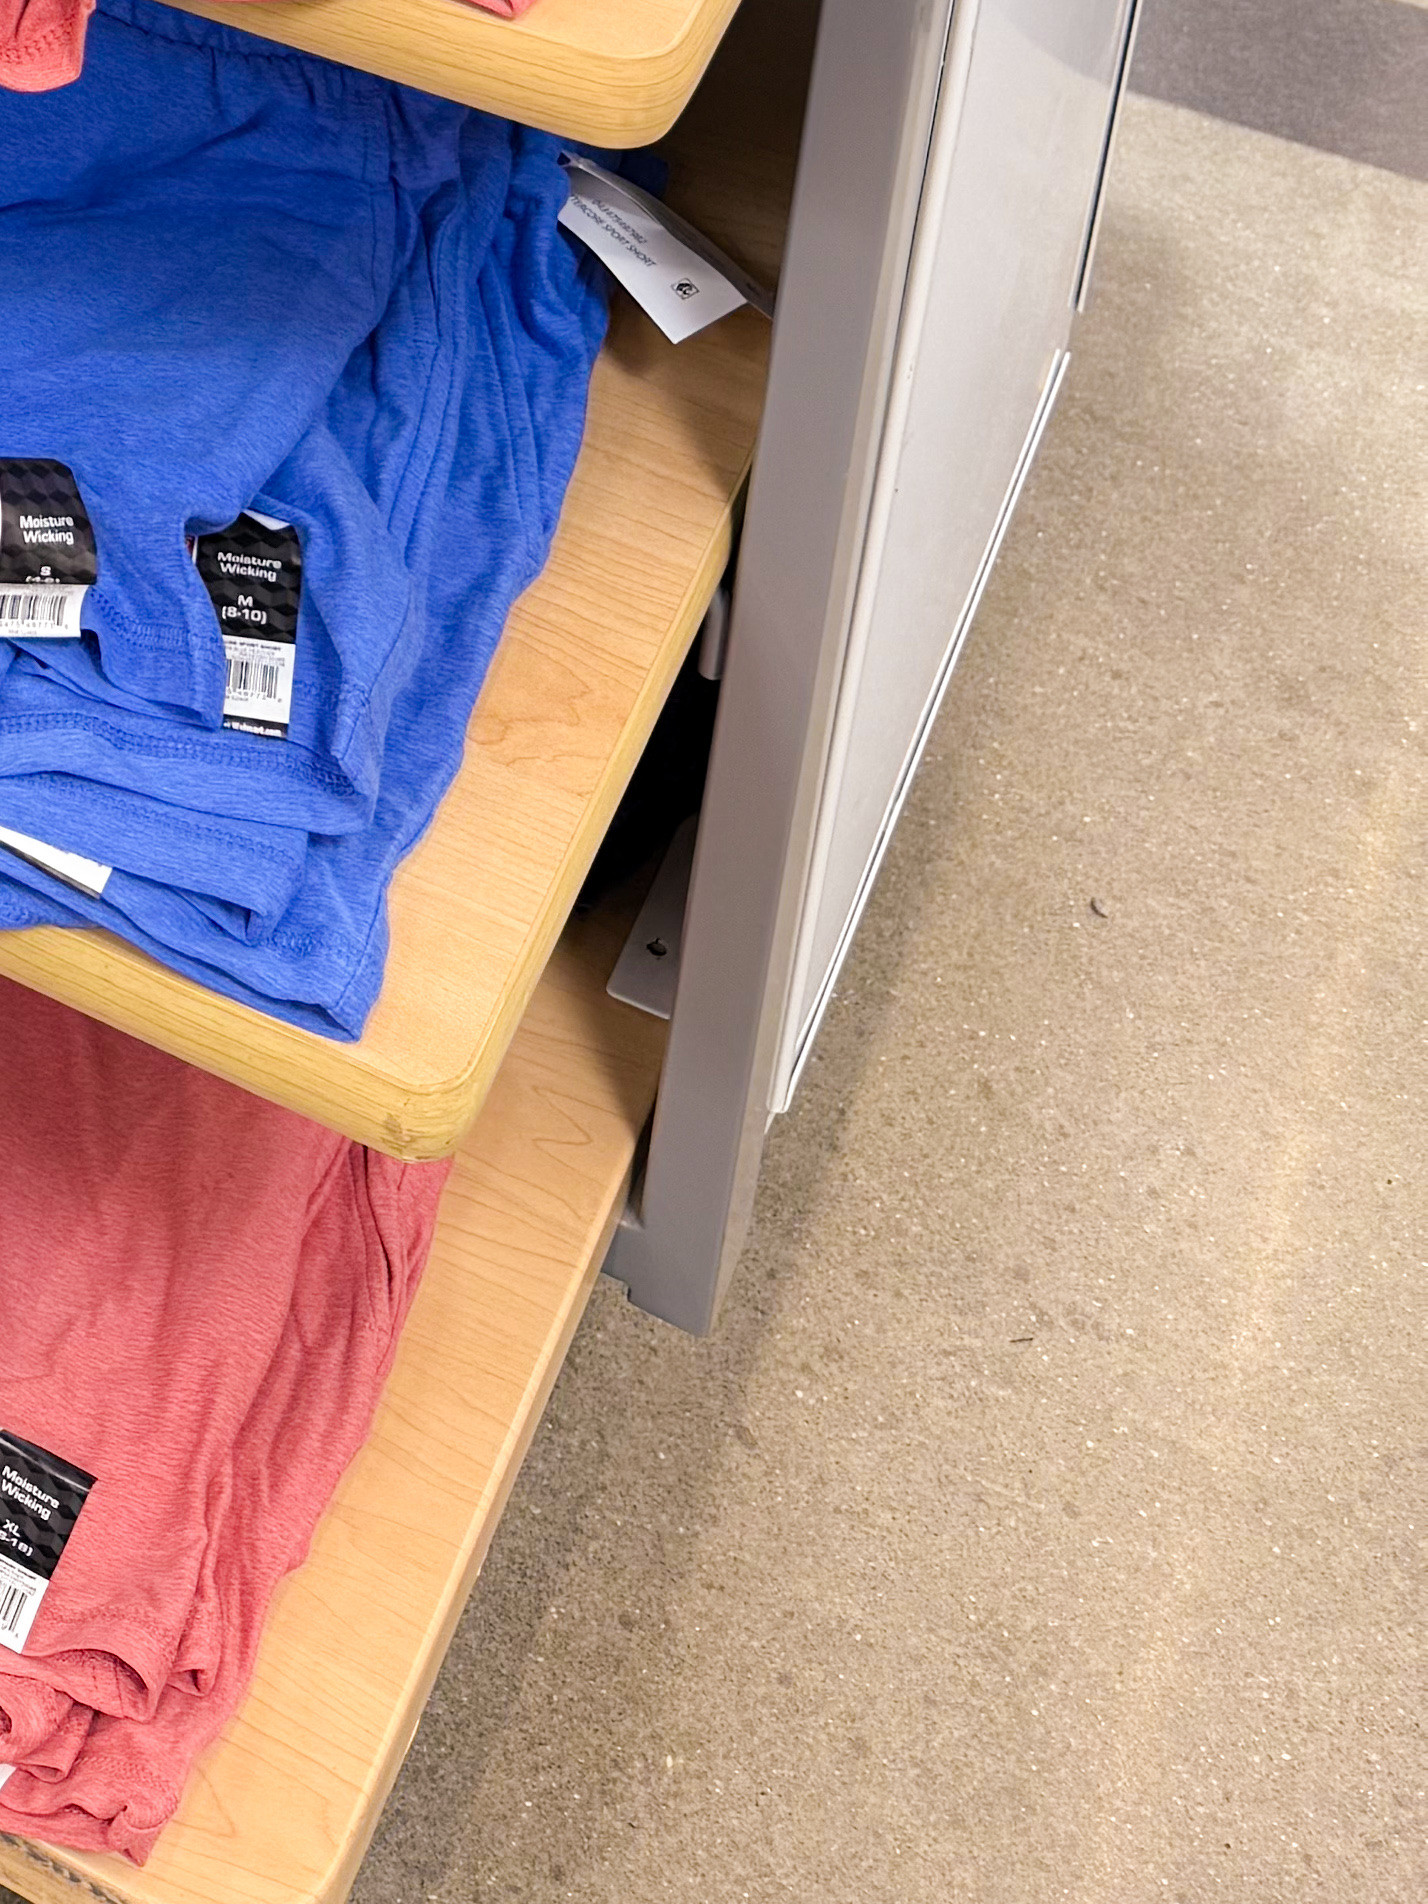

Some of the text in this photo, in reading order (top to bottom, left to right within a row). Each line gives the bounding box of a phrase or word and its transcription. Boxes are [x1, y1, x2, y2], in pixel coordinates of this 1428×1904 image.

[19, 515, 75, 529] Moisture
[22, 530, 75, 546] Wicking
[217, 551, 282, 569] Moisture
[40, 565, 52, 576] S
[219, 562, 277, 582] Wicking
[237, 594, 253, 607] M
[221, 605, 267, 624] (8-10)
[2, 1466, 59, 1510] Moisture
[1, 1479, 52, 1521] Wicking
[2, 1519, 20, 1538] XL
